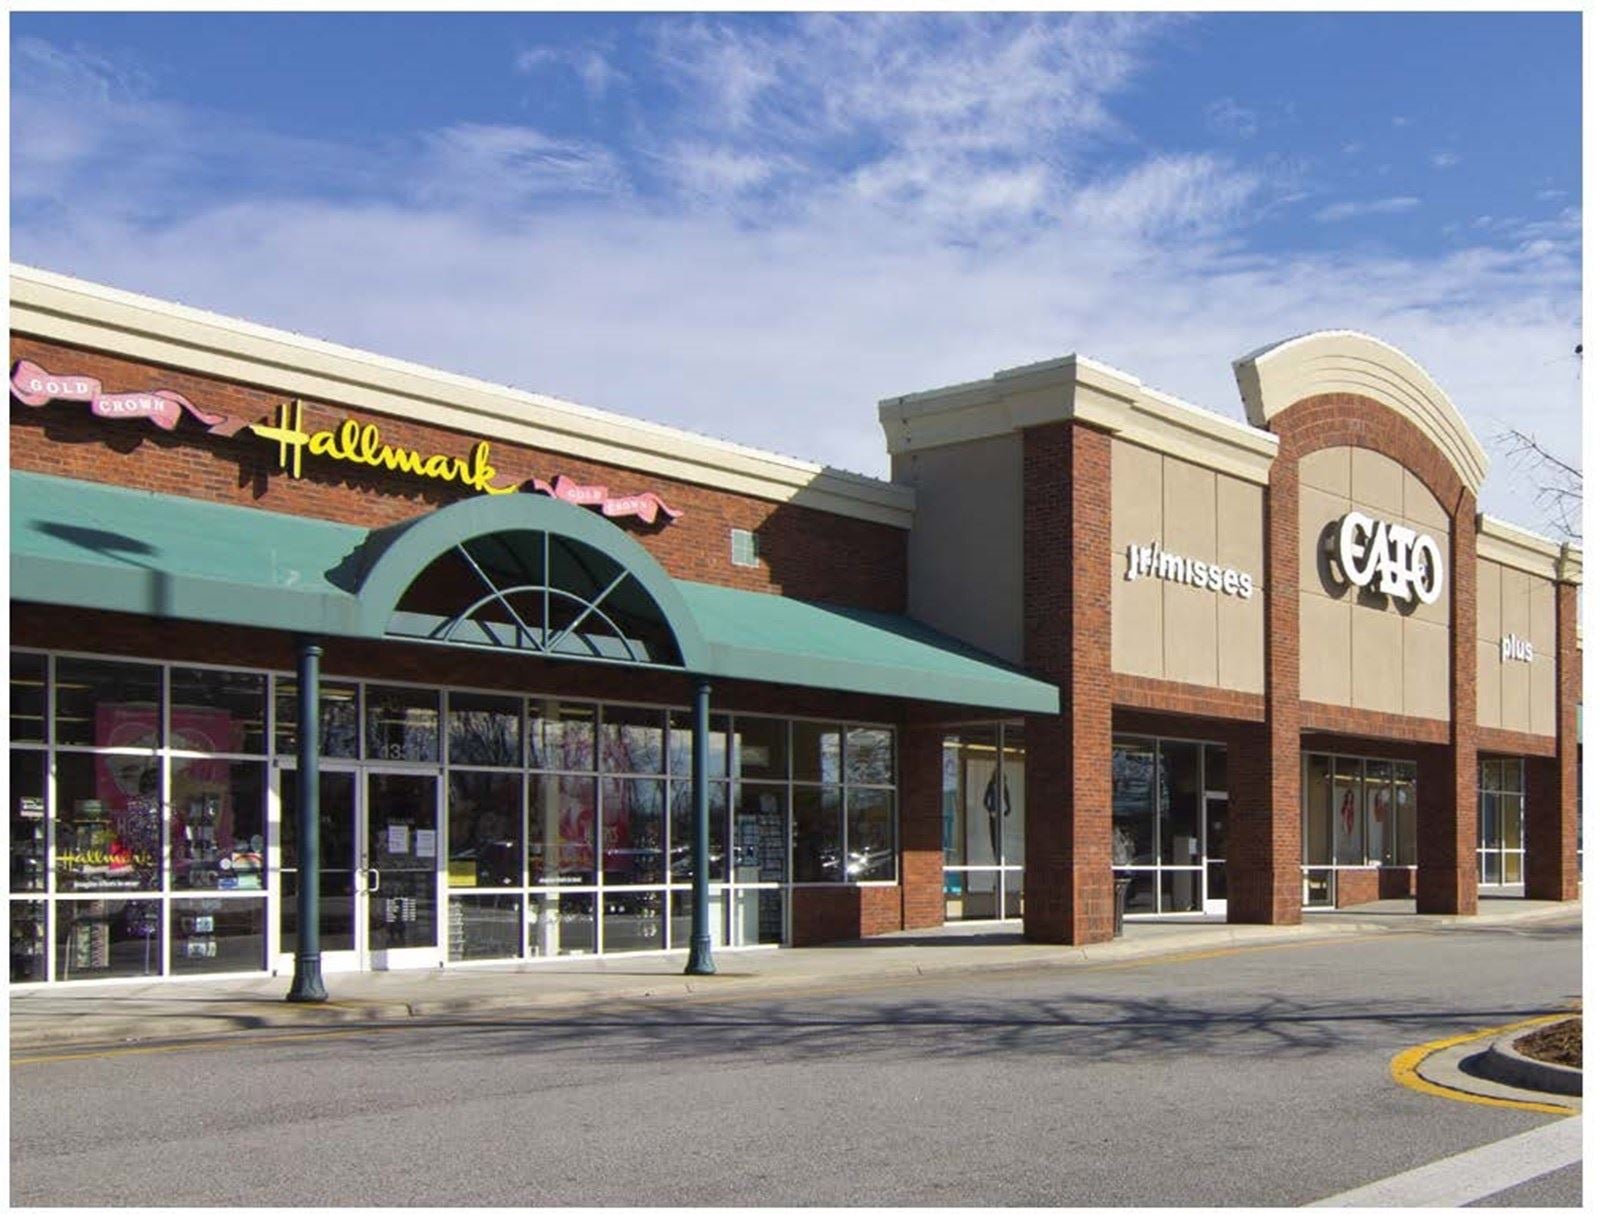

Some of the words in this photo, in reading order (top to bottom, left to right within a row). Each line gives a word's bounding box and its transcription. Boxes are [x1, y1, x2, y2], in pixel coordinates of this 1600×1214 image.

[30, 379, 88, 393] GOLD
[99, 400, 165, 413] CROWN
[249, 399, 517, 495] Hallmark
[1340, 511, 1443, 605] CATO
[1502, 633, 1533, 662] plus
